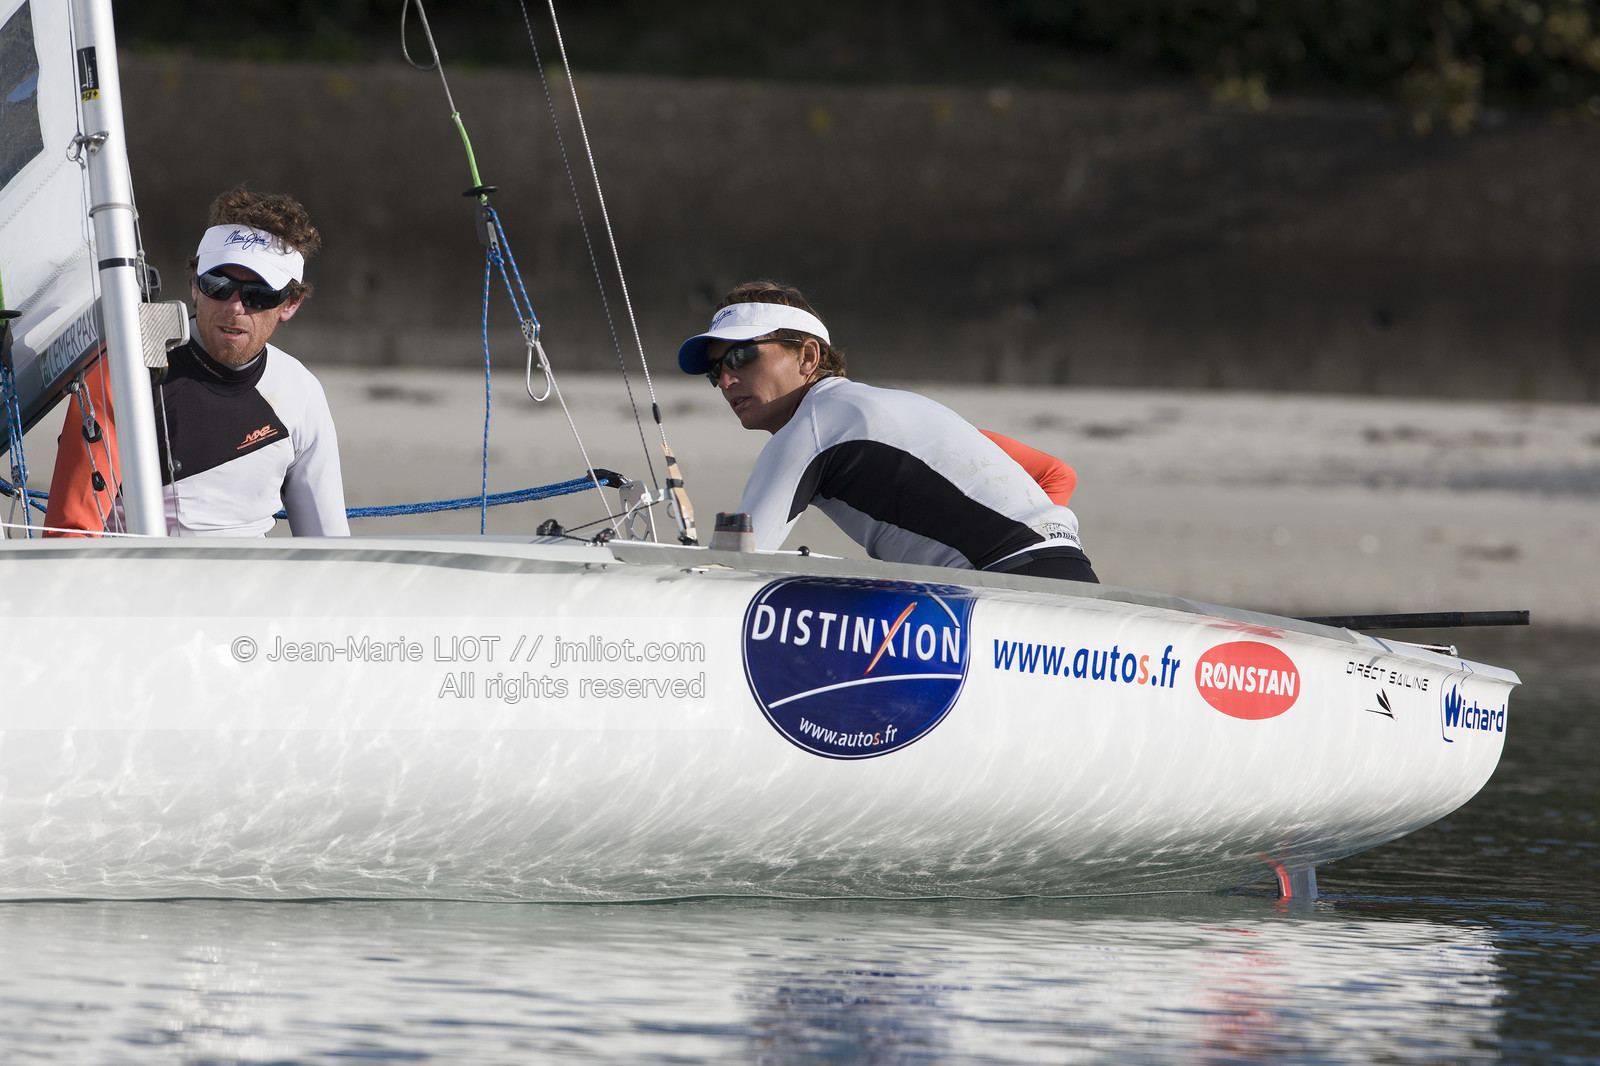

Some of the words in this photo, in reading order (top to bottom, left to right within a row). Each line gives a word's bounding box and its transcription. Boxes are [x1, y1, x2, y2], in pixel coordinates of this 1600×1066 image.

[49, 323, 80, 377] LEMER
[77, 305, 97, 351] PAX
[751, 602, 960, 677] DISTINXION
[993, 638, 1180, 688] www.autos.fr
[1200, 661, 1296, 697] RONSTAN
[1346, 661, 1386, 682] DIRECT
[1389, 671, 1429, 692] SAILING
[1445, 684, 1505, 732] Wichard
[799, 717, 898, 748] www.autos.fr
